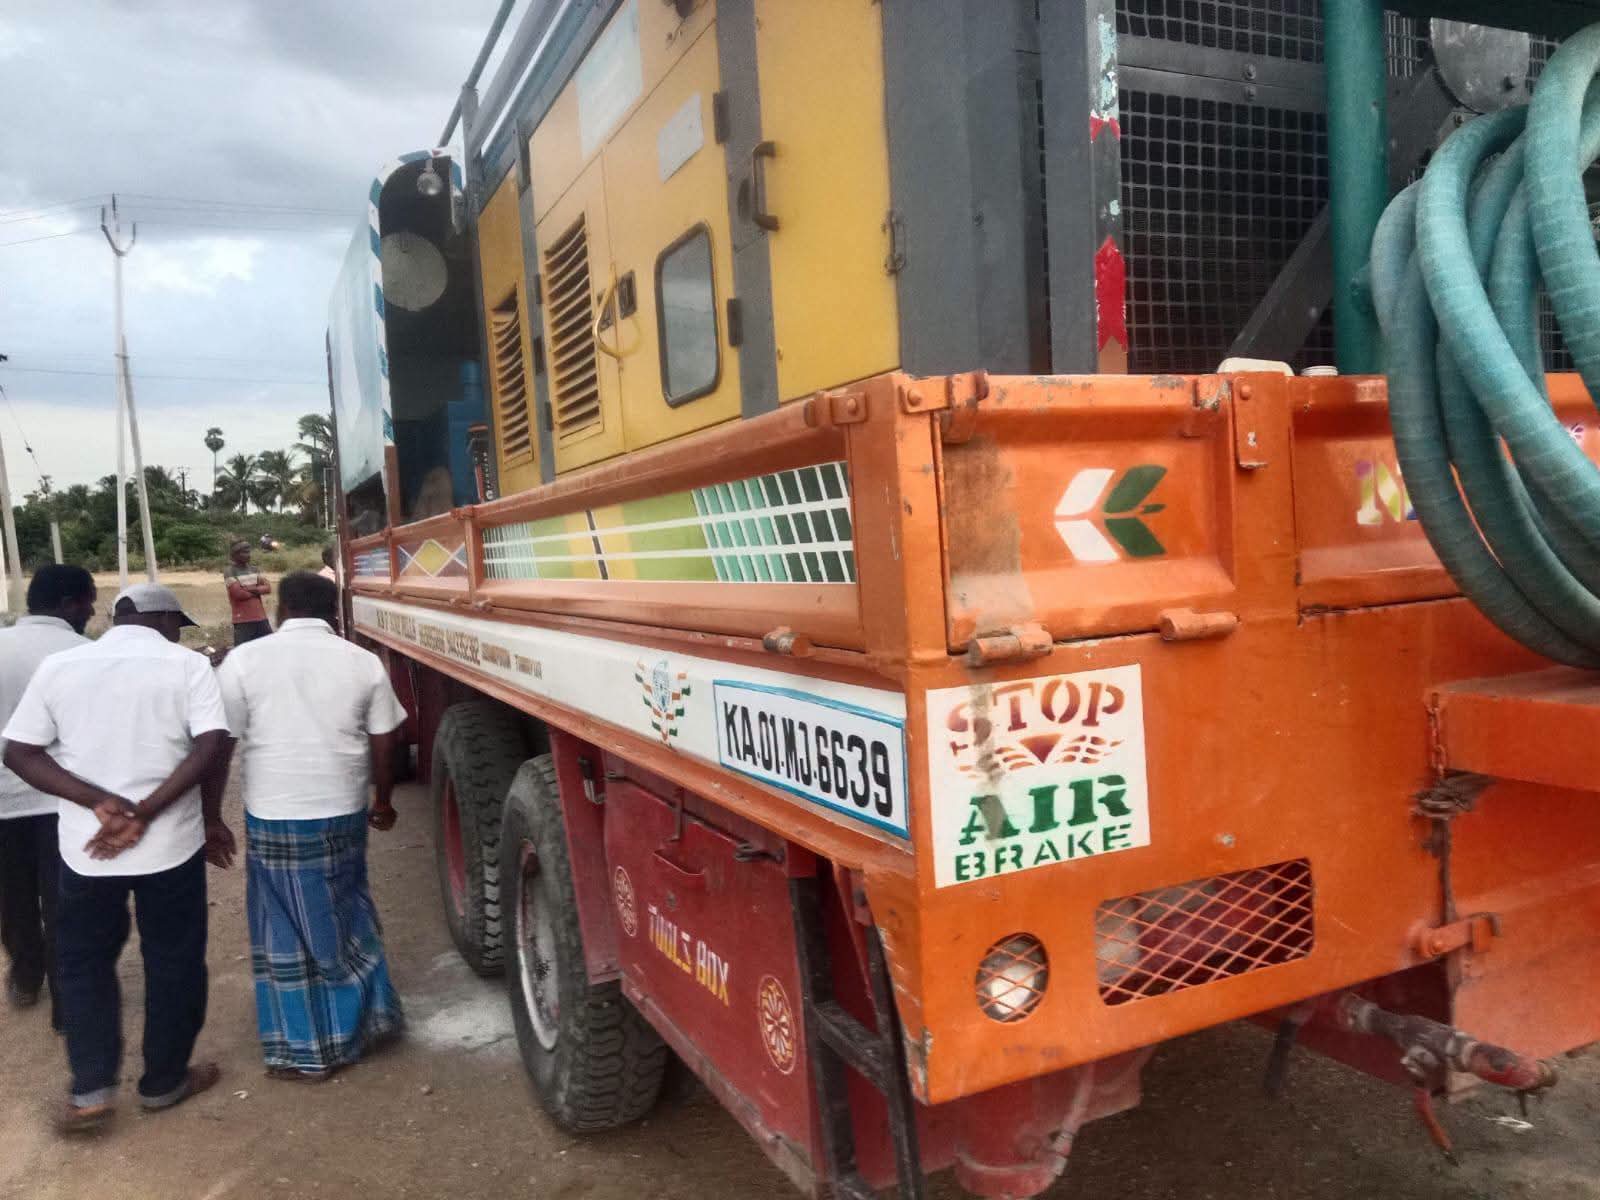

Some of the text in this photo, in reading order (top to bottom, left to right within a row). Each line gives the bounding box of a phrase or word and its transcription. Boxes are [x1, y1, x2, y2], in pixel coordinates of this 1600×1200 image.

[946, 680, 1125, 755] STOP
[723, 701, 893, 817] KA.01.MJ.6639
[958, 775, 1132, 845] AIR
[955, 823, 1132, 881] BRAKE
[696, 940, 729, 1006] BOX
